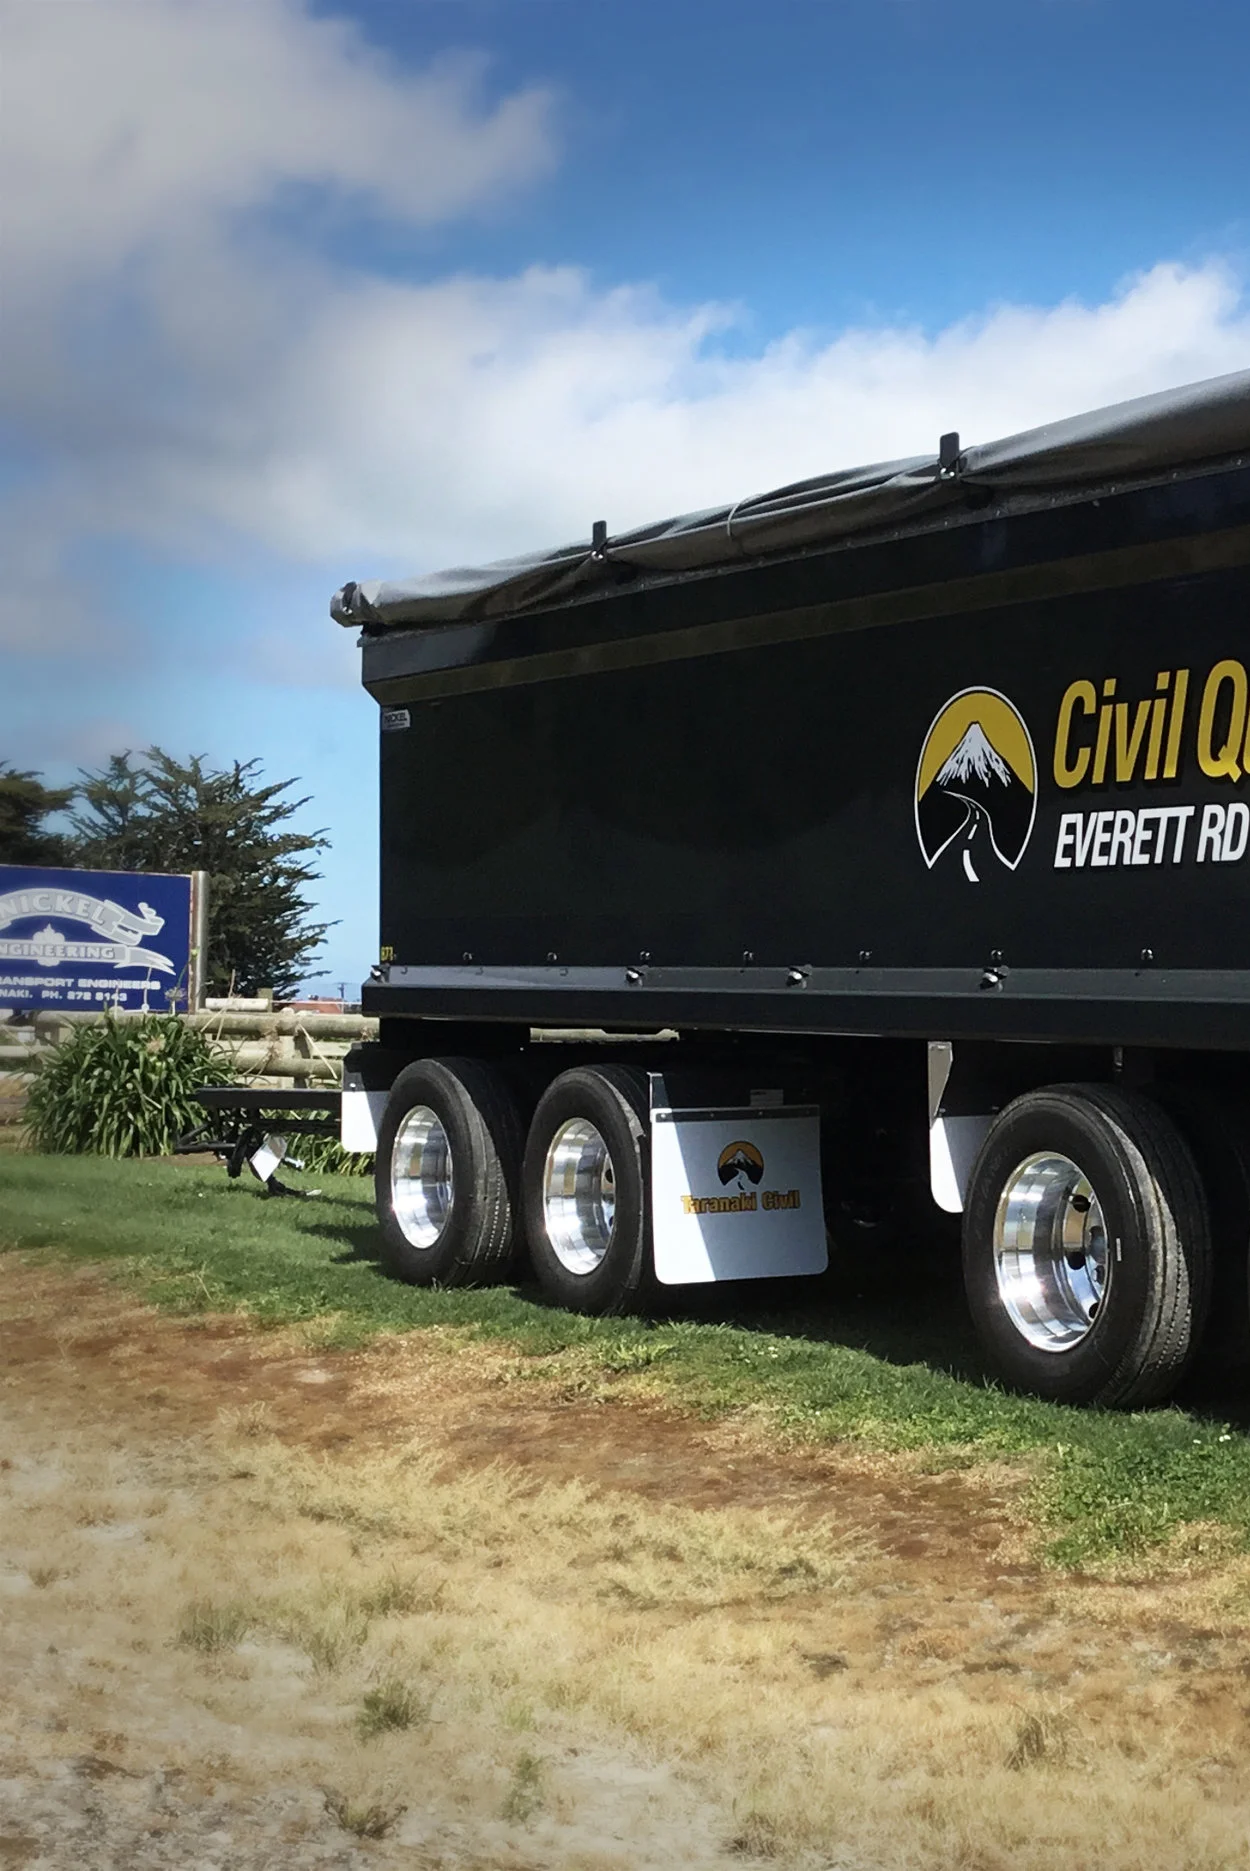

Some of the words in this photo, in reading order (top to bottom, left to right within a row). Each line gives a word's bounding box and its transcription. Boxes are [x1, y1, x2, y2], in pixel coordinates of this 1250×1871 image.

[1053, 668, 1190, 789] Civil
[1053, 805, 1195, 868] EVERETT
[1196, 802, 1250, 863] RD
[681, 1191, 758, 1215] Taranaki
[762, 1190, 800, 1211] Civil
